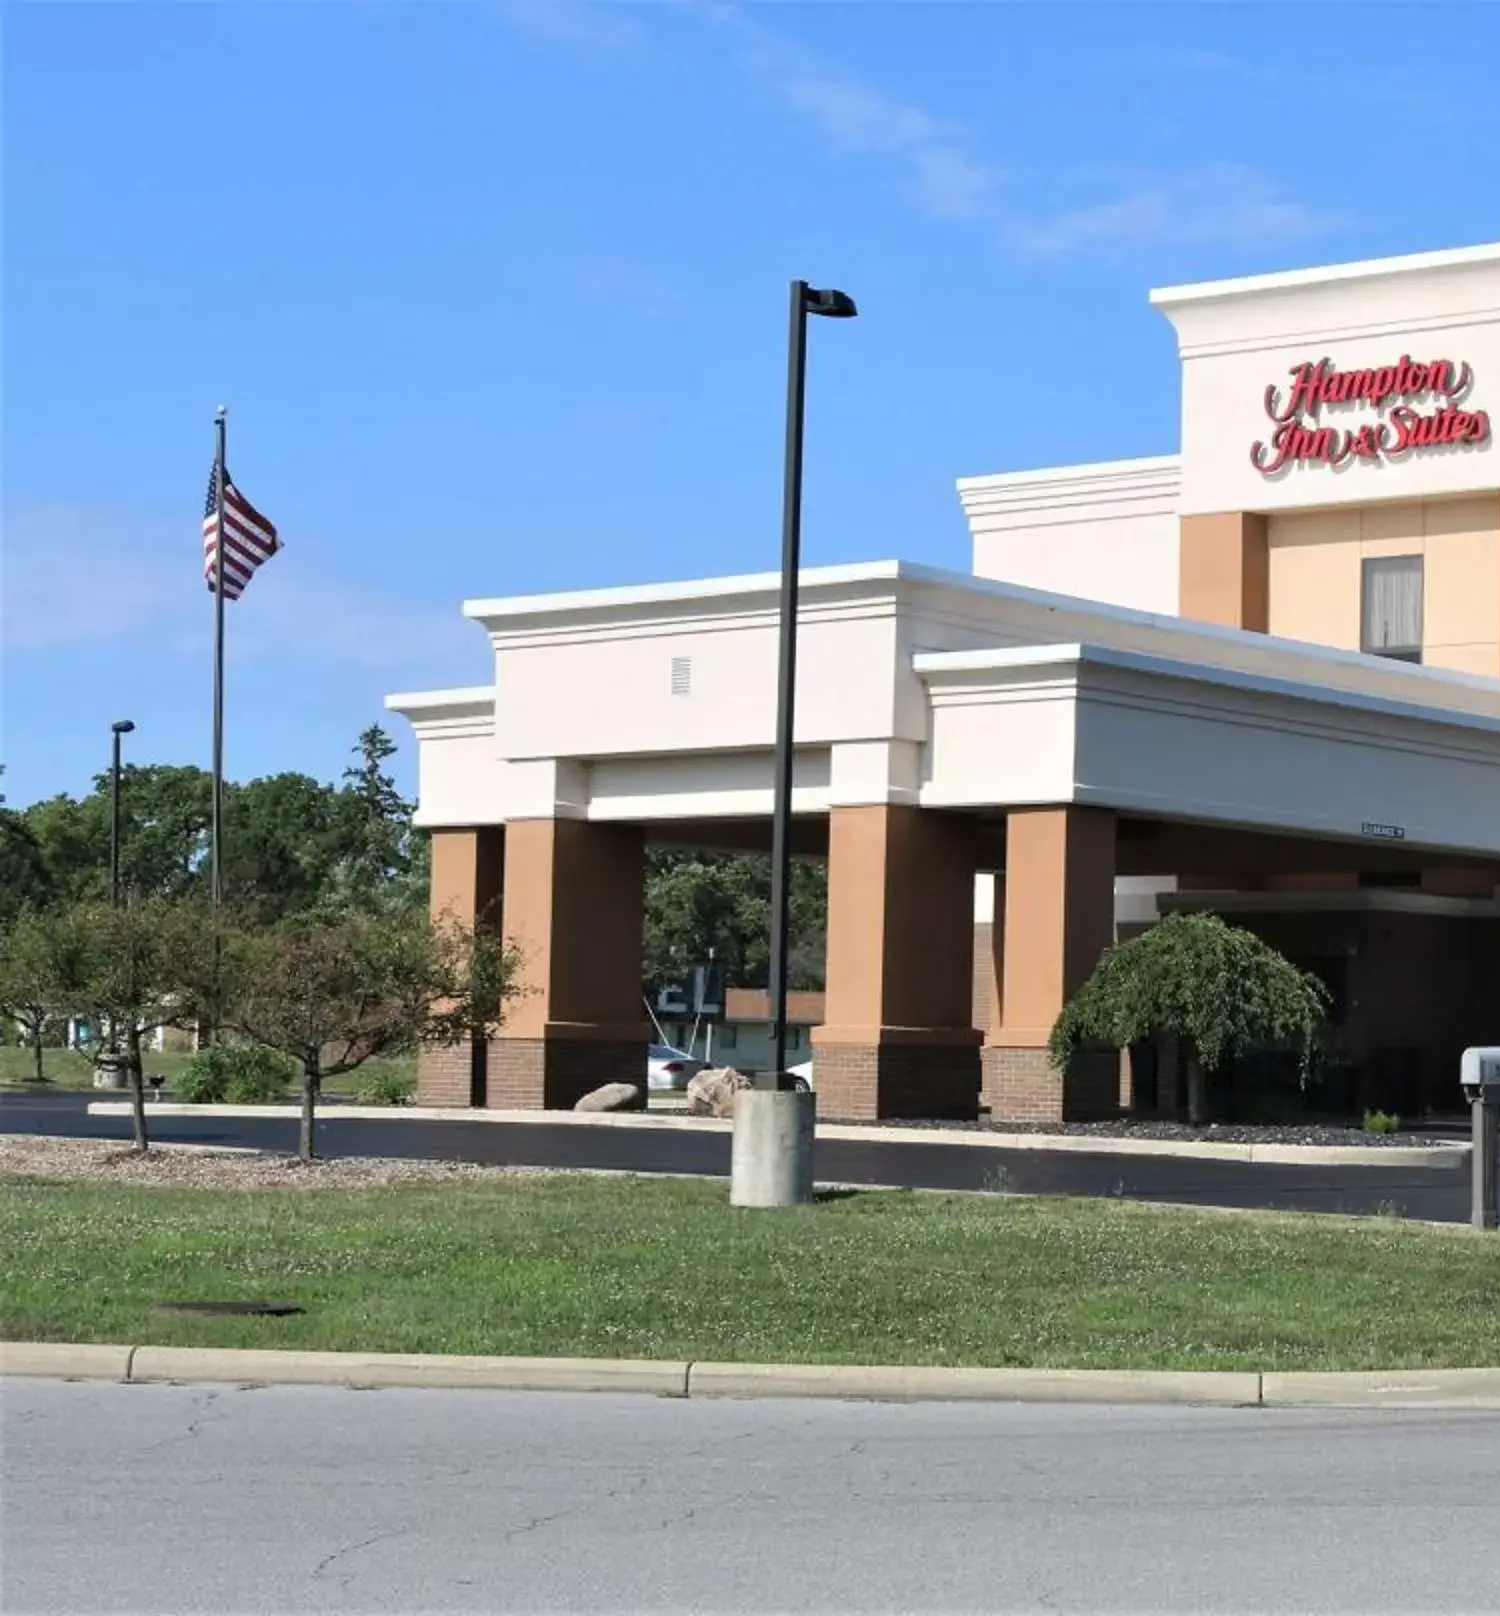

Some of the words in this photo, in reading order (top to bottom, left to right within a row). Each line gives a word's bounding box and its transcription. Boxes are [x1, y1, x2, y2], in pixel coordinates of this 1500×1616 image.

[1264, 354, 1472, 423] Hampton
[1250, 422, 1350, 473] Inn
[1351, 425, 1379, 459] &
[1375, 405, 1489, 454] Suites
